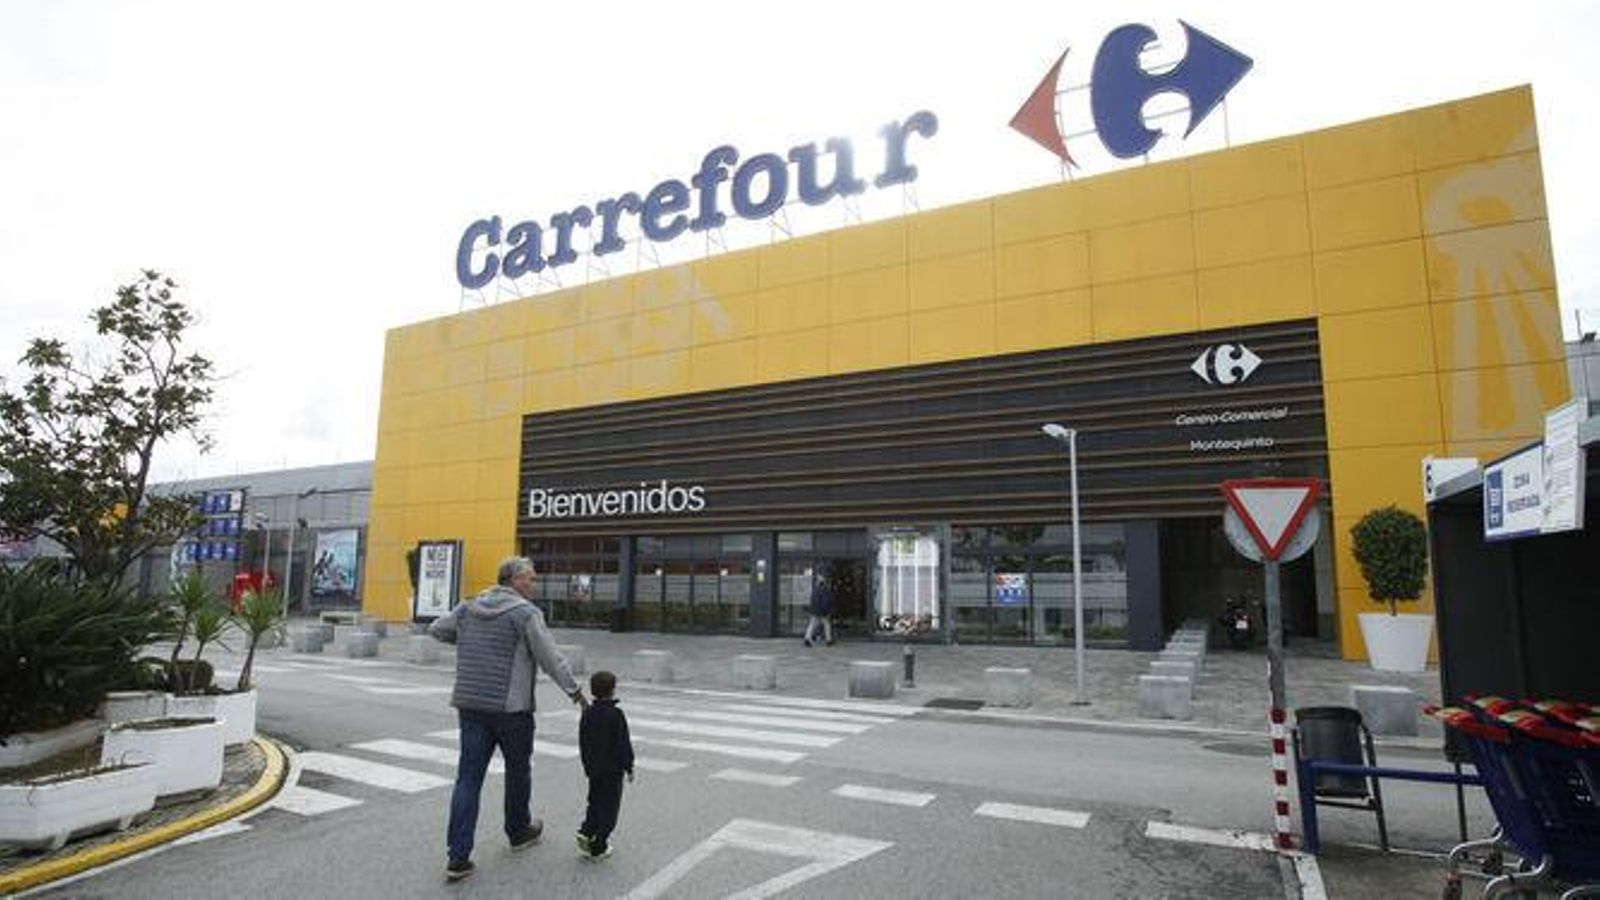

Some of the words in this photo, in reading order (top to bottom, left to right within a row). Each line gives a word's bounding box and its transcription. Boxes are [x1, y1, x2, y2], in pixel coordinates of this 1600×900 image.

[456, 110, 938, 290] Carrefour
[1176, 414, 1219, 425] Centro
[528, 479, 705, 518] Bienvenidos
